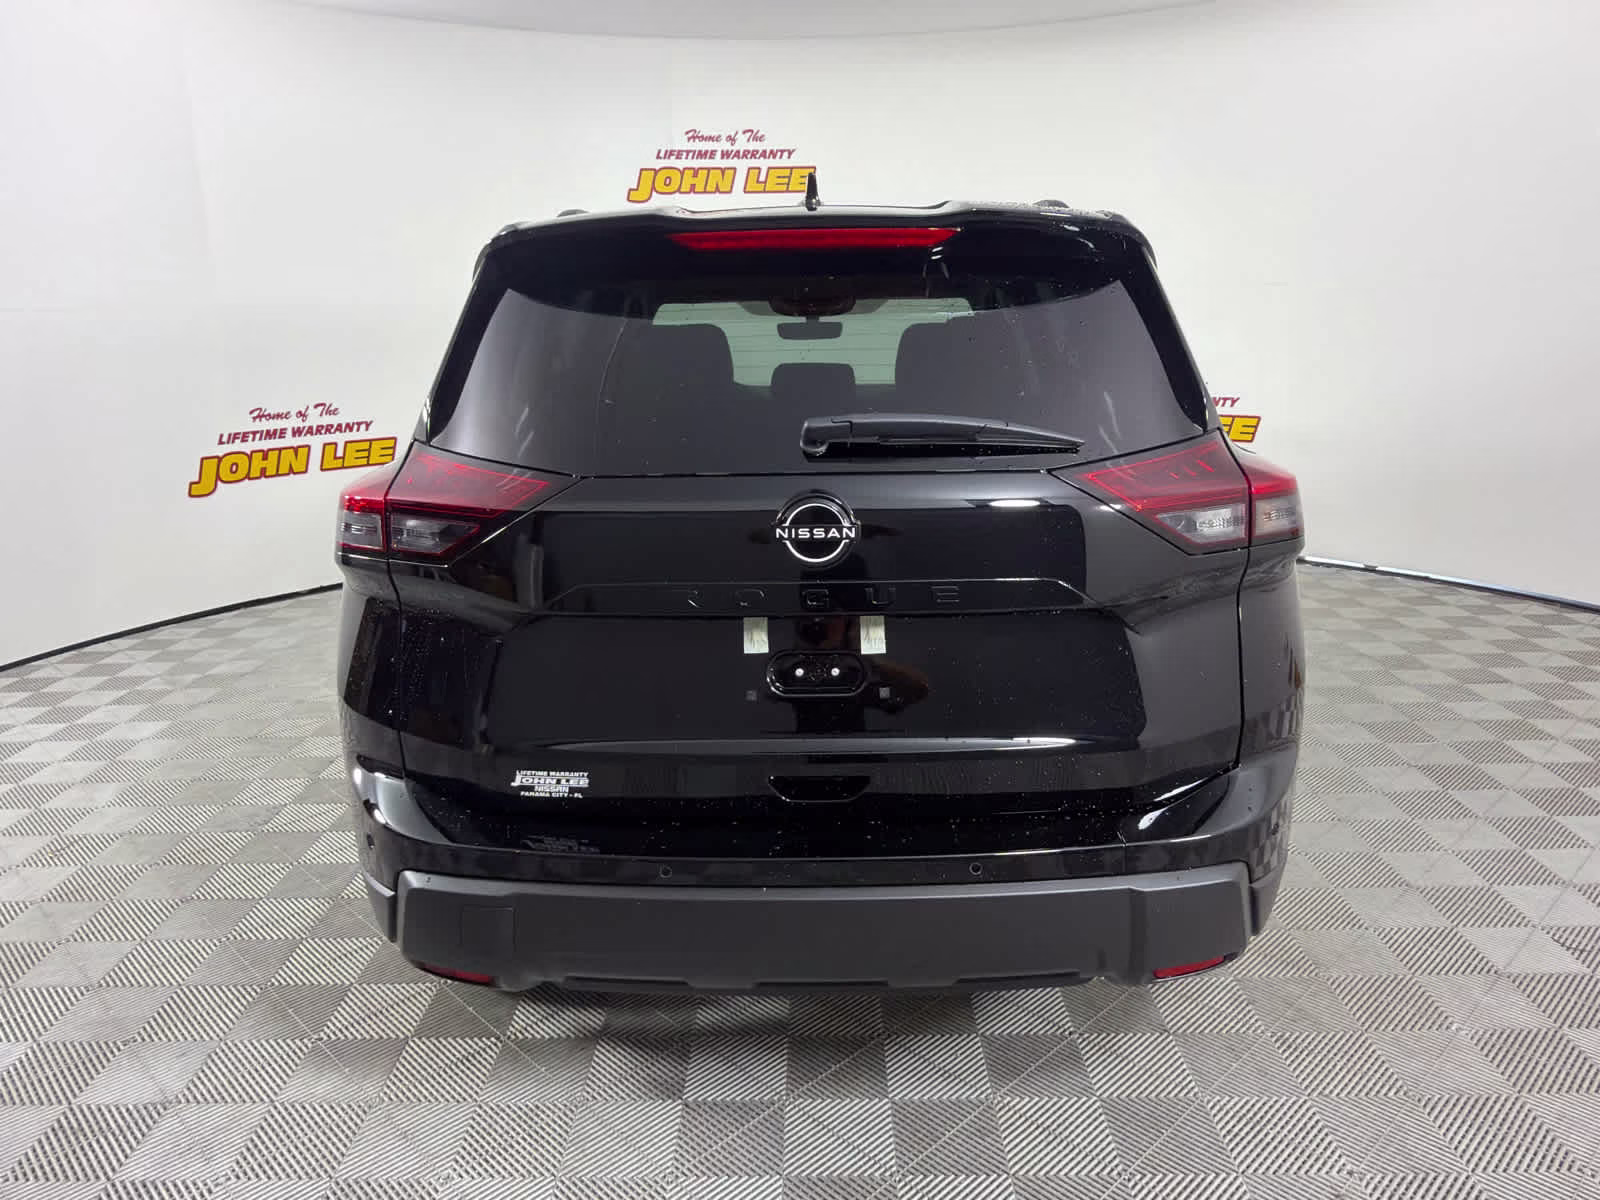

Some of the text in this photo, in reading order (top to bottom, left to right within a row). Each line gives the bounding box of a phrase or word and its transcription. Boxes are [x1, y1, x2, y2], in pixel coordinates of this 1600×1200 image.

[684, 129, 766, 146] Home of The
[656, 148, 796, 160] LIFETIME WARRANTY
[626, 166, 816, 203] JOHN LEE
[248, 402, 340, 422] Home of The
[217, 420, 374, 446] LIFETIME WARRANTY
[188, 437, 397, 498] JOHN LEE
[775, 527, 856, 539] NISSAN
[510, 771, 589, 787] JOHN LEE
